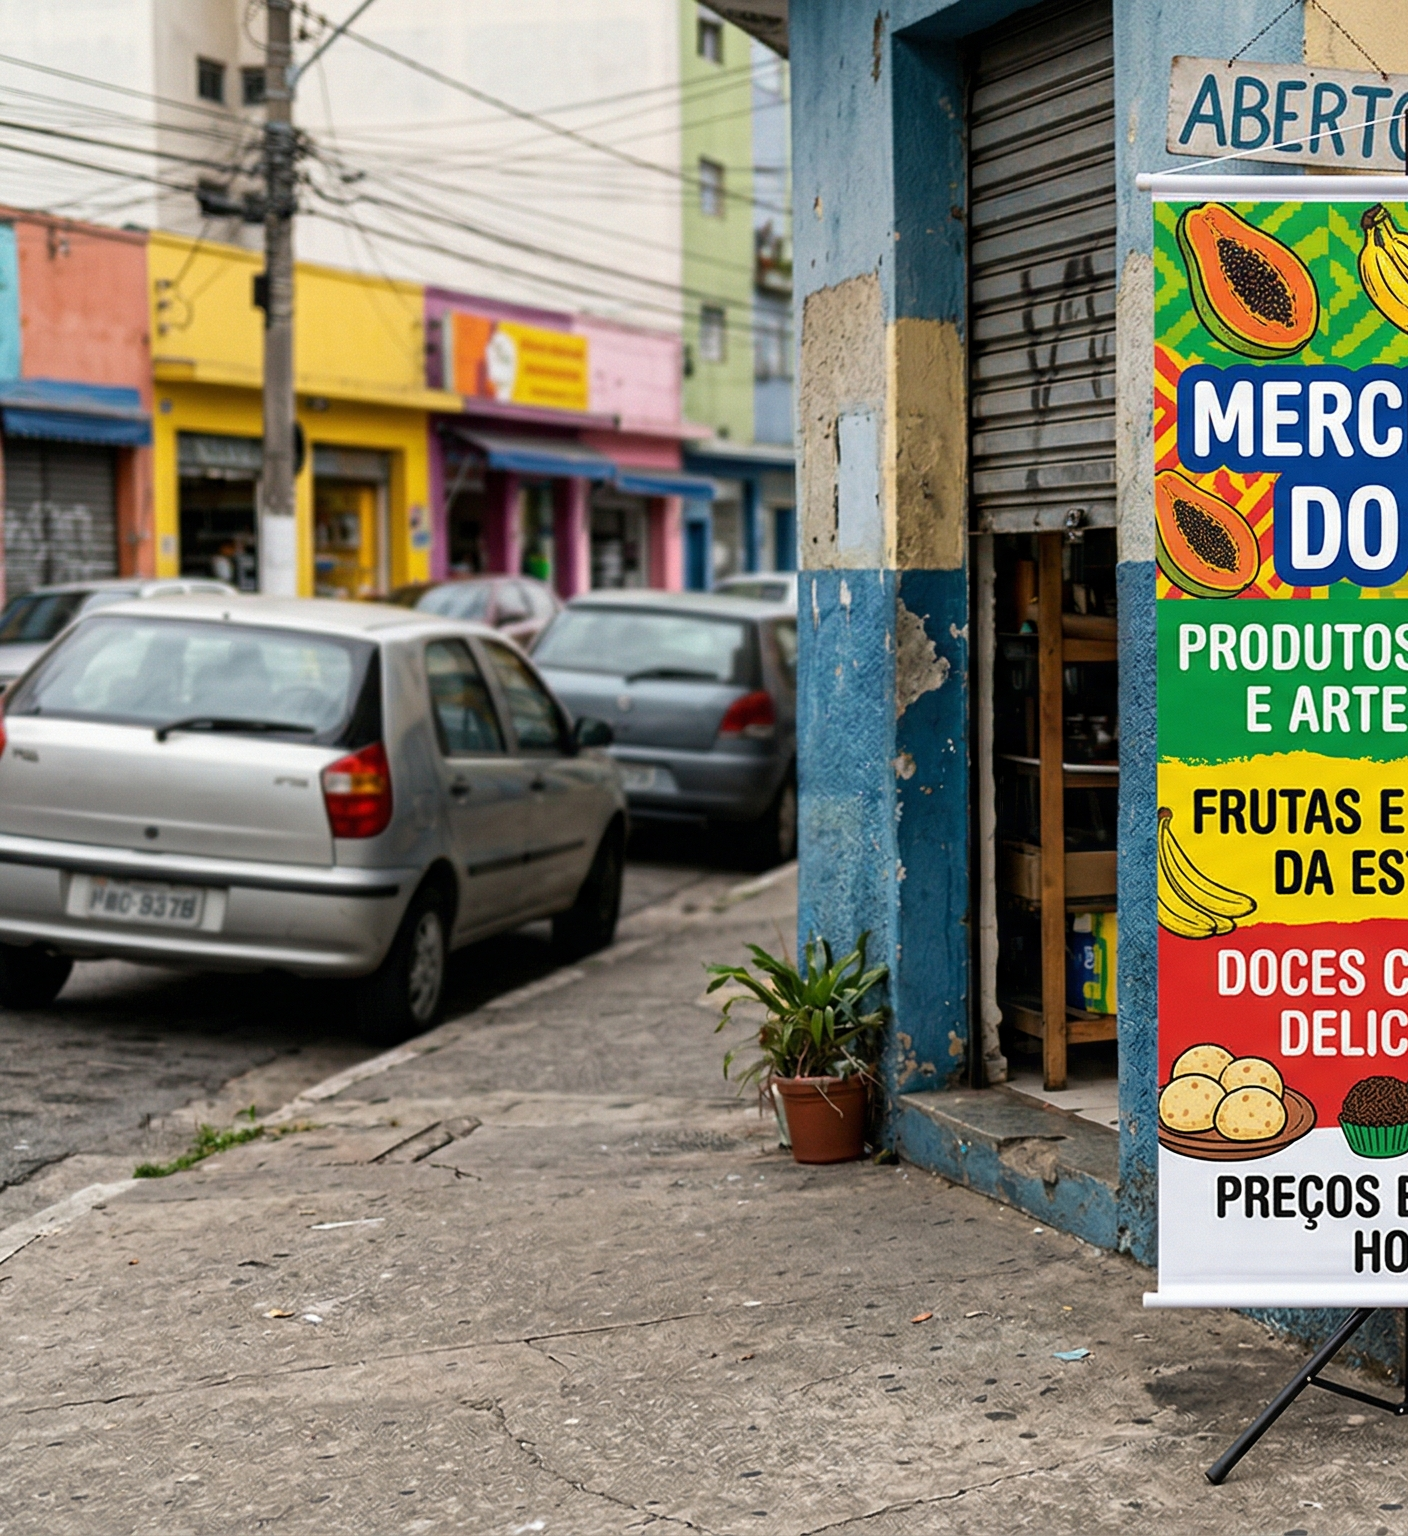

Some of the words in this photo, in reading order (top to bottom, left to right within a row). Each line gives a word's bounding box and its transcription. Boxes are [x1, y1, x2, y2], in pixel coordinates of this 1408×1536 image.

[1291, 485, 1400, 571] DO
[1247, 686, 1273, 733] E
[1193, 788, 1363, 836] FRUTAS
[1380, 788, 1406, 836] E
[1275, 849, 1335, 897] DA
[1218, 948, 1367, 997] DOCES
[1217, 1174, 1382, 1231] PREÇOS
